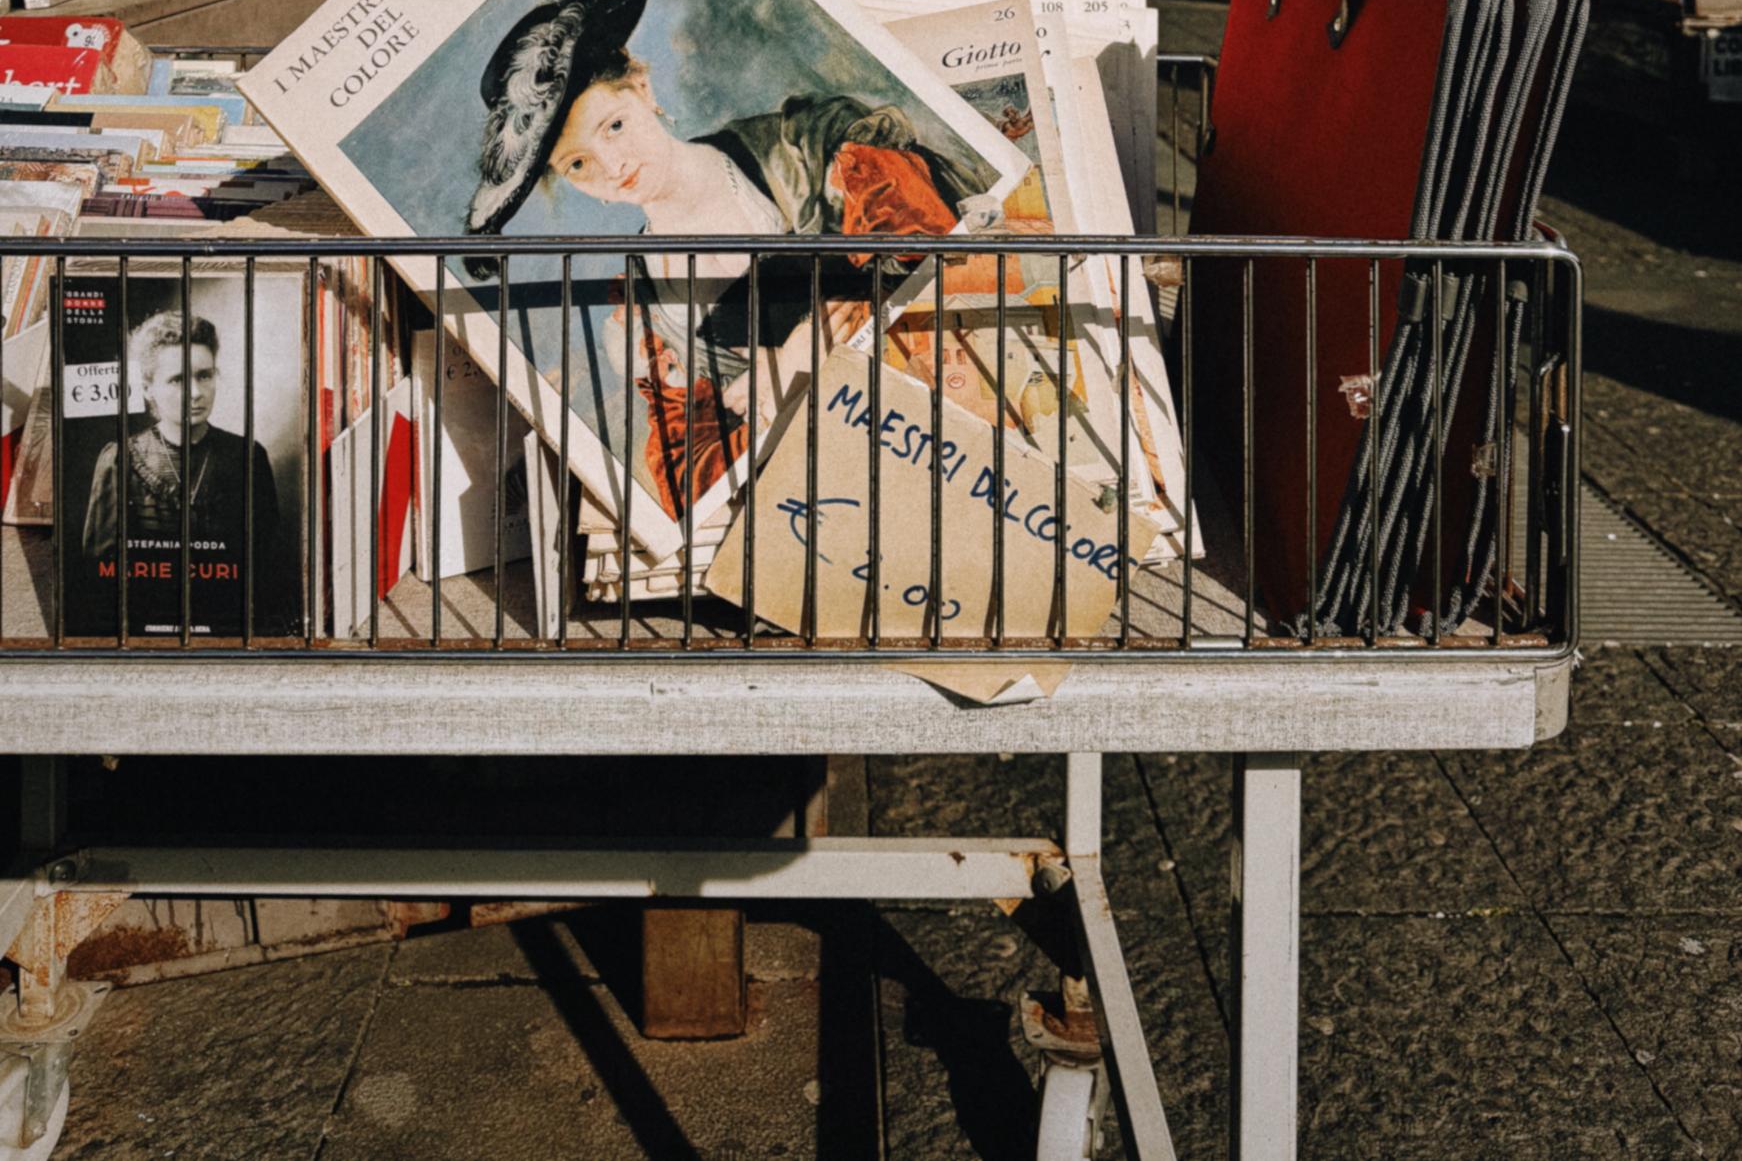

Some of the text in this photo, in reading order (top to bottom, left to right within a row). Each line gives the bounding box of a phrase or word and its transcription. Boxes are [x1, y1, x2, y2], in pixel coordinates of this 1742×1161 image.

[993, 6, 1016, 22] 26
[1040, 1, 1064, 14] 108
[1083, 1, 1109, 14] 205
[355, 8, 405, 51] DEL
[941, 39, 1022, 69] Giotto
[329, 20, 421, 108] COLORE
[273, 77, 288, 96] I
[66, 290, 104, 299] GRANDI
[65, 308, 104, 316] DELLA
[66, 317, 104, 325] STORIA
[127, 539, 226, 550] STEFANIA ODDA
[1023, 504, 1138, 581] COORE
[98, 561, 173, 578] MRIE
